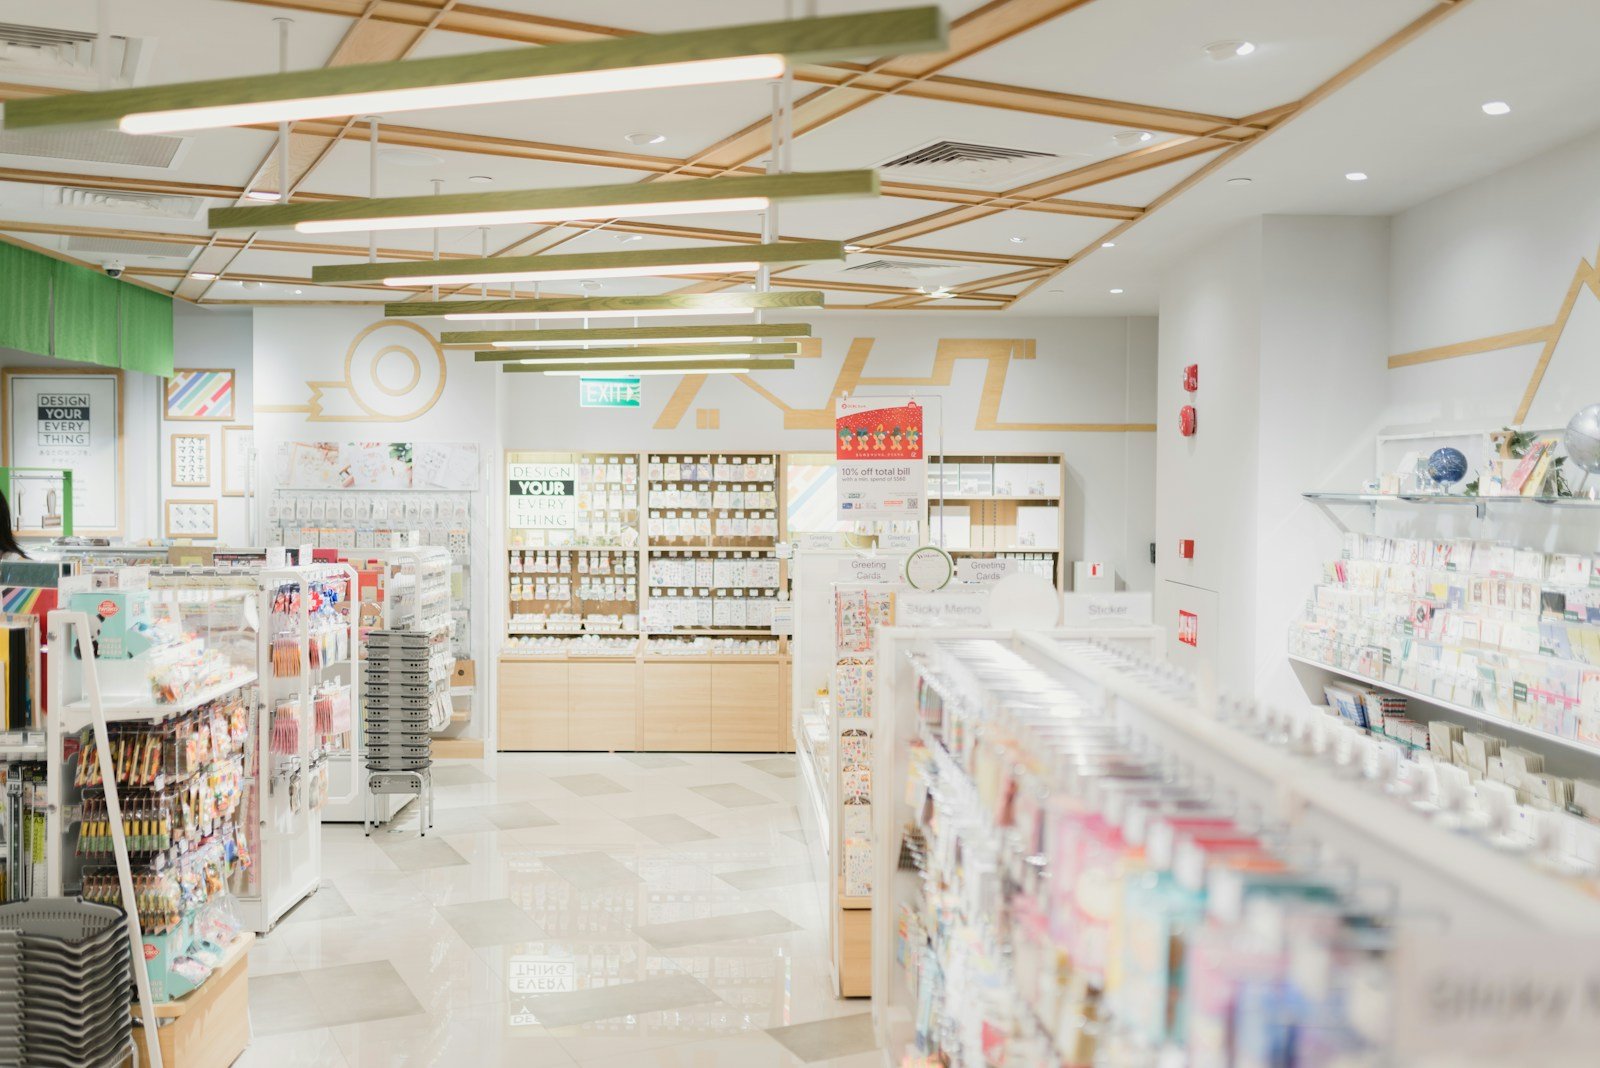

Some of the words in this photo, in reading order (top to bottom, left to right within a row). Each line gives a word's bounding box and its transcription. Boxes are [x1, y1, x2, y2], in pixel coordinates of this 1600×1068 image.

[587, 384, 621, 402] EXIT
[40, 396, 87, 406] DESIGN
[45, 408, 82, 419] YOUR
[44, 422, 84, 431] EVERY
[43, 434, 84, 444] THING
[513, 466, 570, 477] DESIGN
[841, 467, 859, 476] 10%
[860, 467, 873, 476] off
[875, 467, 895, 476] total
[897, 467, 911, 476] bill
[518, 481, 565, 495] YOUR
[518, 498, 567, 509] EVERY
[517, 514, 567, 526] THING
[809, 534, 833, 542] Greeting
[887, 534, 911, 542] Greeting
[851, 561, 887, 571] Greeting
[970, 561, 1006, 572] Greeting
[856, 572, 881, 580] Cards
[976, 572, 1001, 580] Cards
[906, 604, 942, 616] Sticky
[944, 604, 982, 615] Memo
[1088, 604, 1128, 615] Sticker
